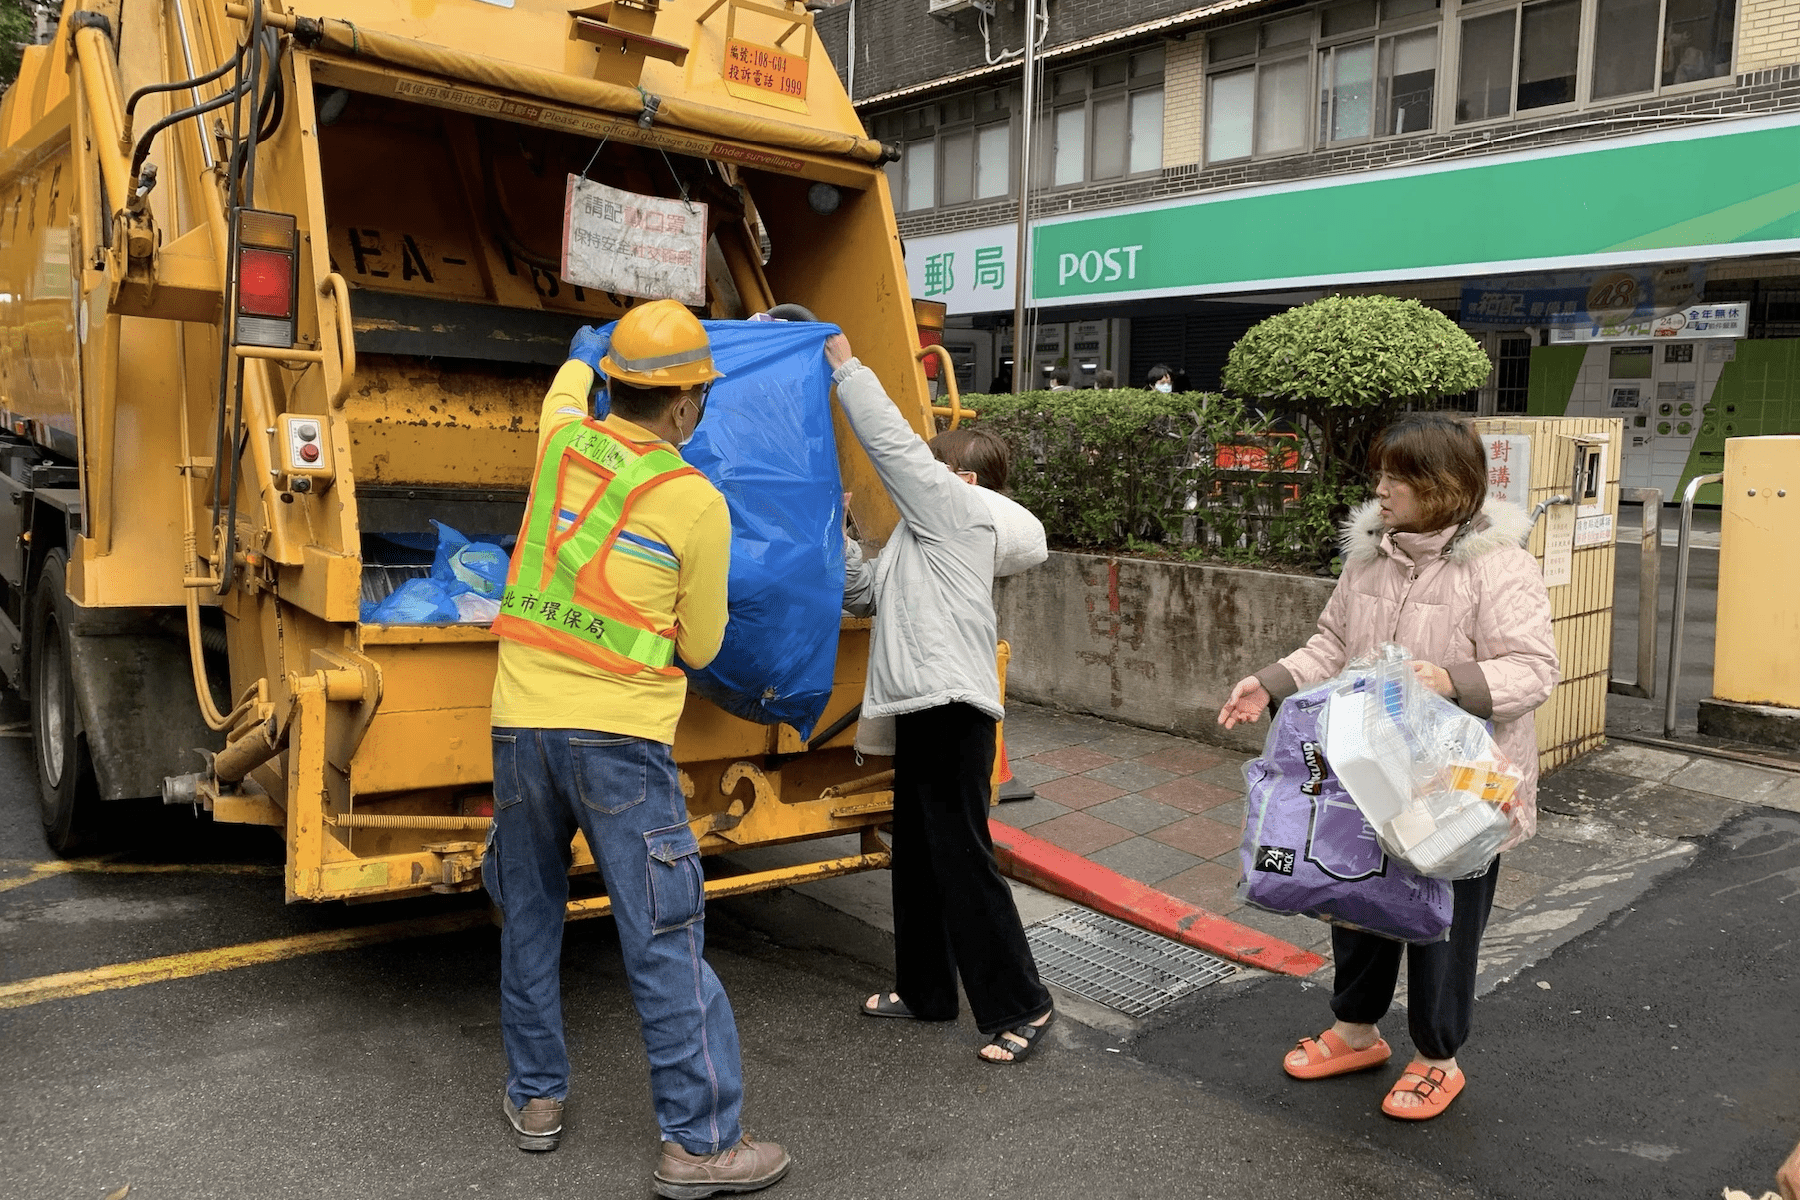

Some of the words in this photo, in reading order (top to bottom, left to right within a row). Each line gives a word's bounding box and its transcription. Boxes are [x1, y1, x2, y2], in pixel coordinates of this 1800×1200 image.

[399, 80, 501, 110] 請使用專用垃圾袋
[728, 64, 774, 88] 投訴電話
[780, 76, 802, 96] 1999
[544, 111, 580, 128] Please
[581, 120, 601, 131] use
[603, 123, 640, 139] official
[640, 130, 684, 150] garbage
[685, 138, 712, 152] bags
[714, 145, 744, 158] Under
[745, 151, 802, 170] surveillance
[574, 227, 692, 266] 保持安全社交距離
[924, 246, 1005, 297] 郵局
[1059, 244, 1143, 286] POST
[1588, 278, 1634, 310] 48
[1688, 308, 1740, 320] 全年無休
[502, 590, 606, 640] 北市環保局
[1265, 849, 1283, 871] 24
[1283, 852, 1295, 873] PACK
